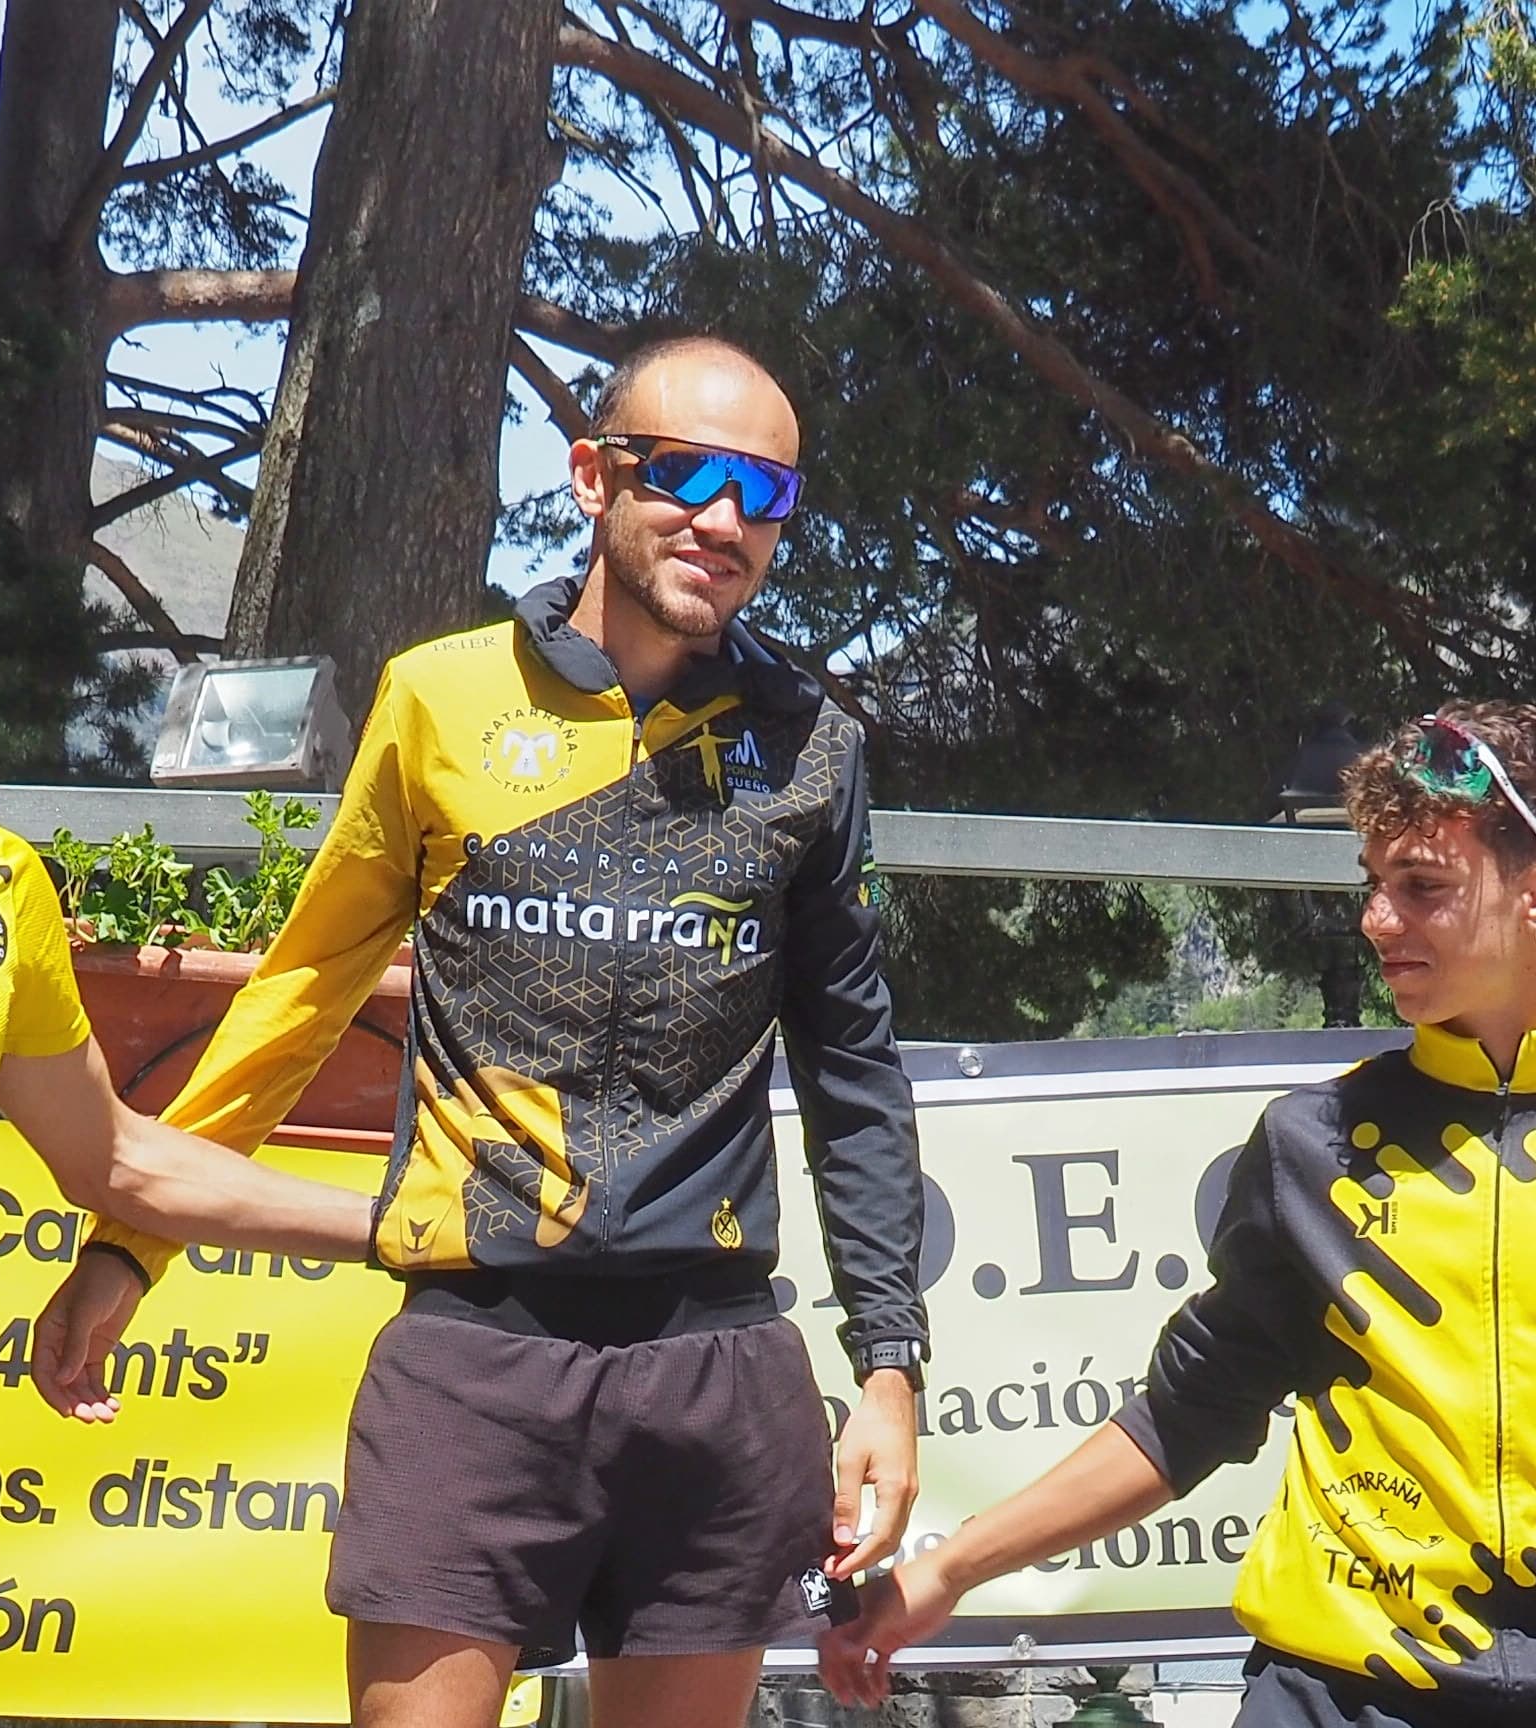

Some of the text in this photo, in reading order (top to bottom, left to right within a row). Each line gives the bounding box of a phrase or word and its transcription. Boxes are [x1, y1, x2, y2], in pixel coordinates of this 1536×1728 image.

[482, 707, 578, 752] MATARRAÑA
[504, 781, 545, 793] TEAM
[727, 777, 770, 793] SUEÑO
[466, 838, 775, 883] COMARCA DEL
[89, 1459, 340, 1533] distan
[1320, 1471, 1422, 1510] MATARRAÑA
[1324, 1549, 1415, 1600] TEAM
